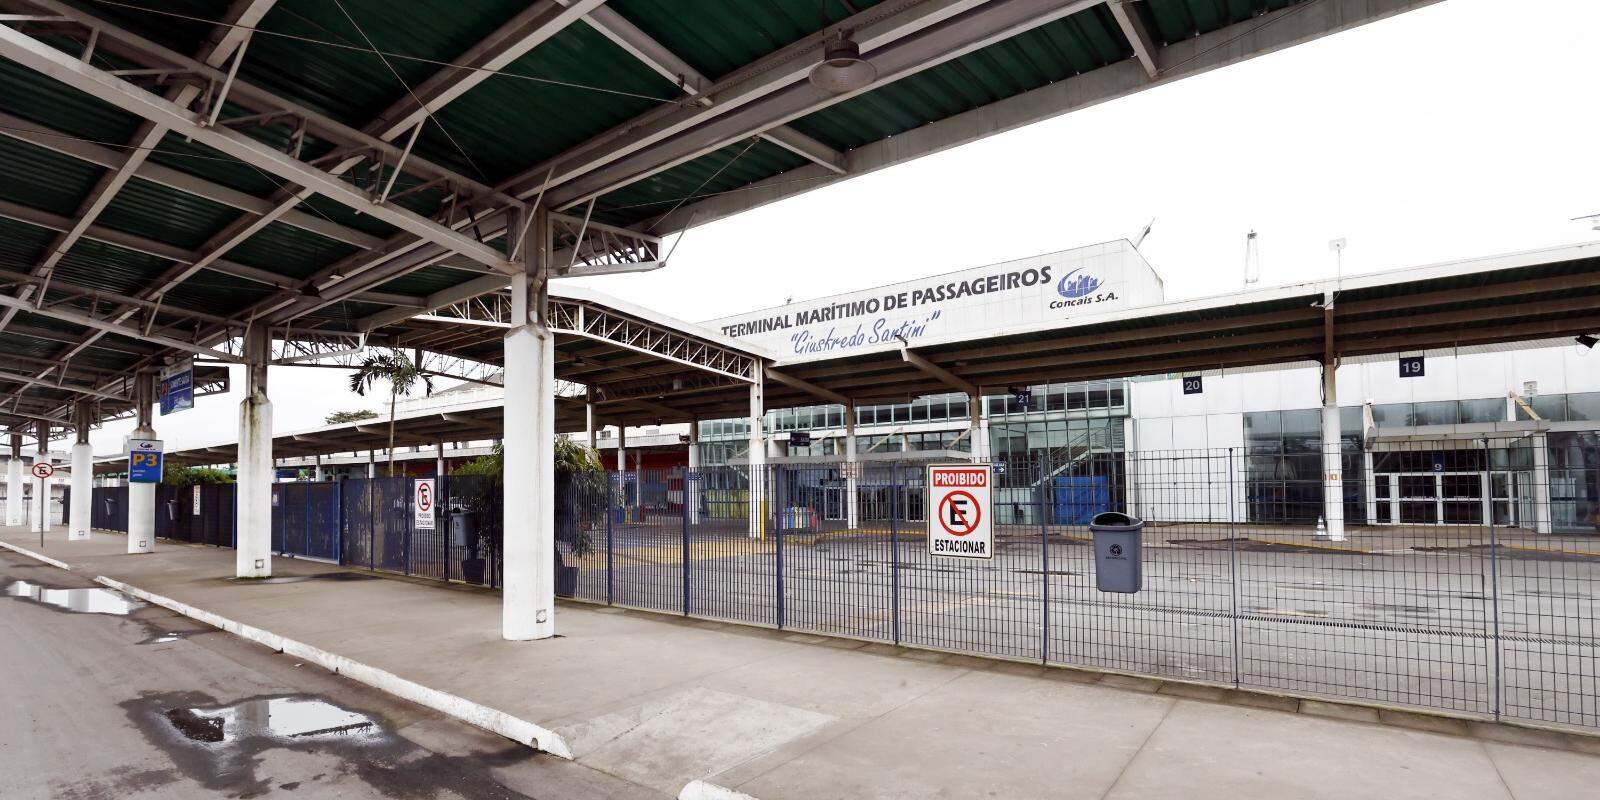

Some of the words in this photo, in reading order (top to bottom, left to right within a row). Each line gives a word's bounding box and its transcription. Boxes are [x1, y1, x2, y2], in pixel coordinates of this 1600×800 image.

[721, 315, 792, 338] TERMINAL
[795, 298, 880, 327] MARÍTIMO
[883, 292, 908, 311] DE
[912, 266, 1052, 306] PASSAGEIROS
[1050, 296, 1092, 309] Concais
[1095, 292, 1119, 303] S.A.
[1402, 362, 1421, 373] 19
[1185, 380, 1200, 391] 20
[1018, 394, 1029, 403] 21
[132, 453, 158, 467] P3
[935, 472, 985, 485] PROIBIDO
[934, 539, 986, 554] ESTACIONAR
